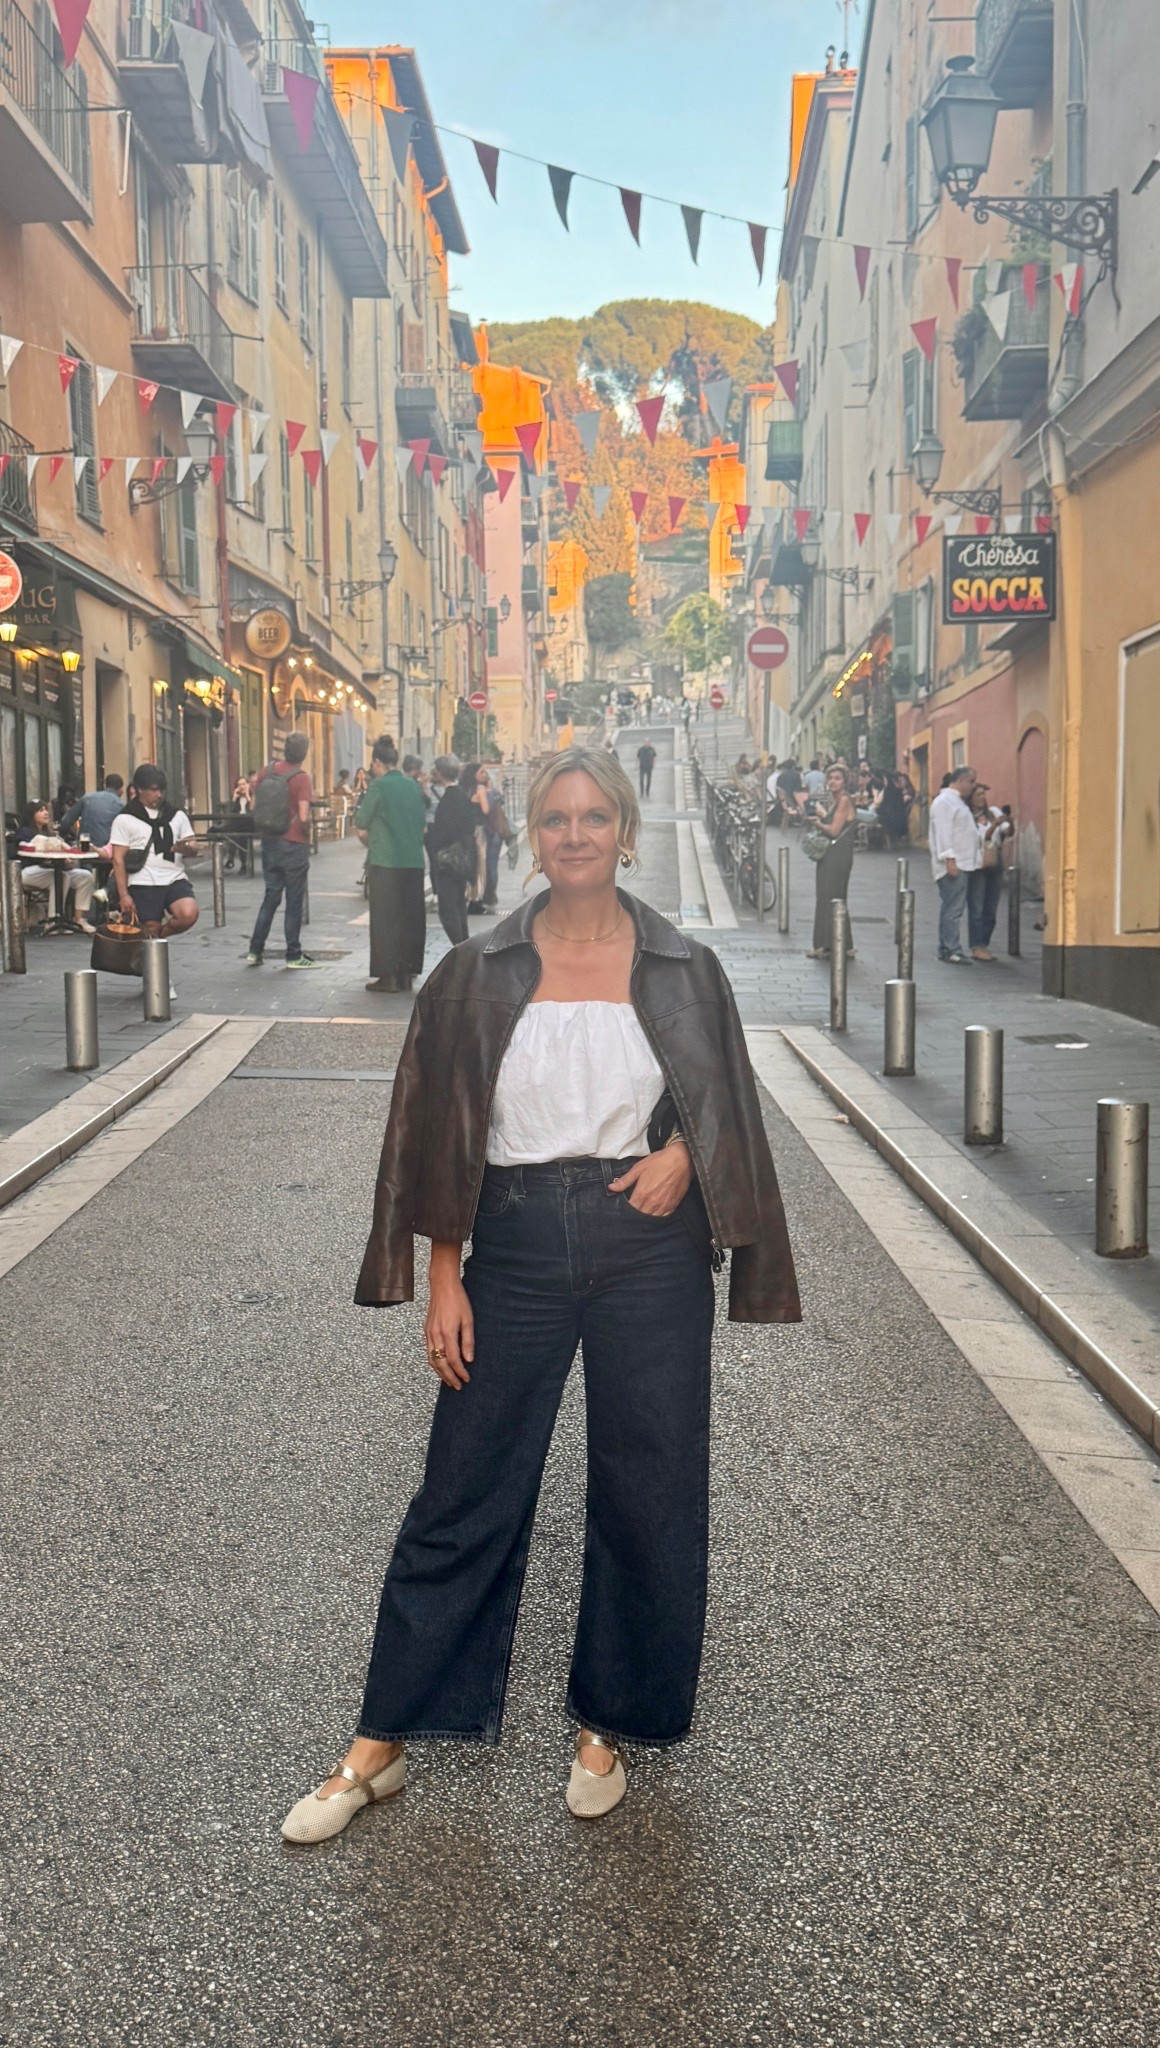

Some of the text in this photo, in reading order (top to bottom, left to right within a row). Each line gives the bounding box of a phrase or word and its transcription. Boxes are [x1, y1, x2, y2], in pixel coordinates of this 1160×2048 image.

[20, 585, 57, 616] UG
[952, 577, 1048, 613] SOCCA
[25, 613, 51, 624] BAR
[258, 627, 279, 639] BEER
